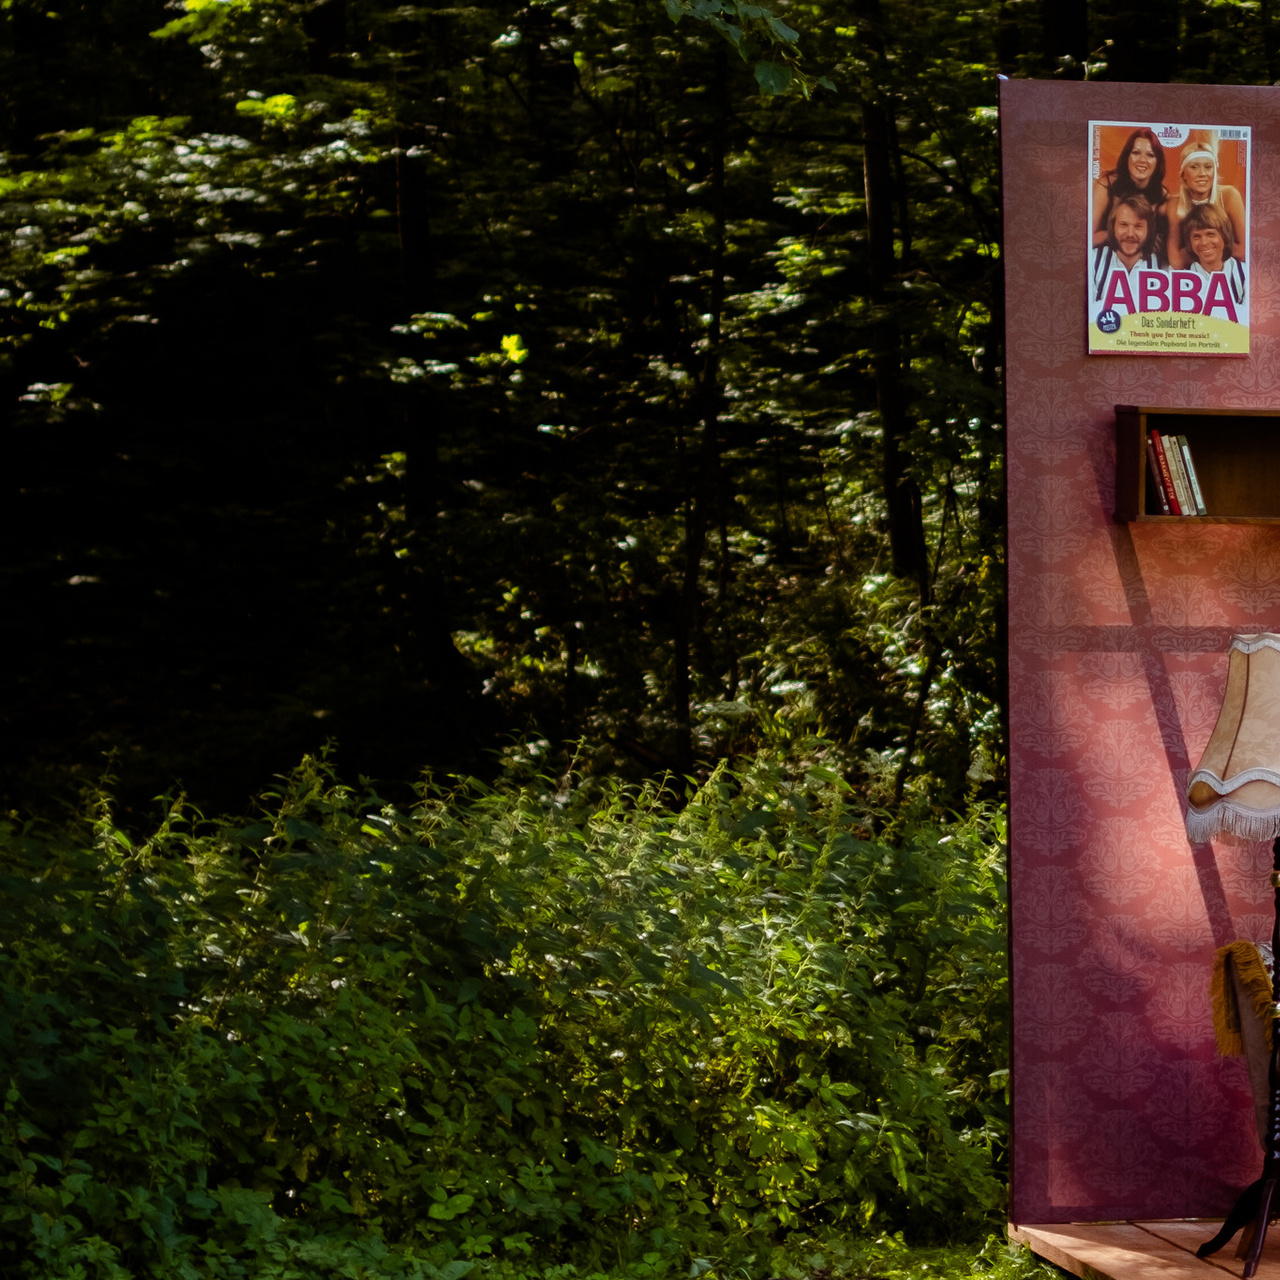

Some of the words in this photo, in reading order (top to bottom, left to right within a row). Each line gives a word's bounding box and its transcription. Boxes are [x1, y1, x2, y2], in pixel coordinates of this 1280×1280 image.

[1102, 270, 1239, 324] ABBA
[1141, 316, 1154, 328] Das
[1155, 316, 1196, 330] Sonderheft
[1165, 331, 1175, 339] for
[1188, 331, 1210, 339] music!
